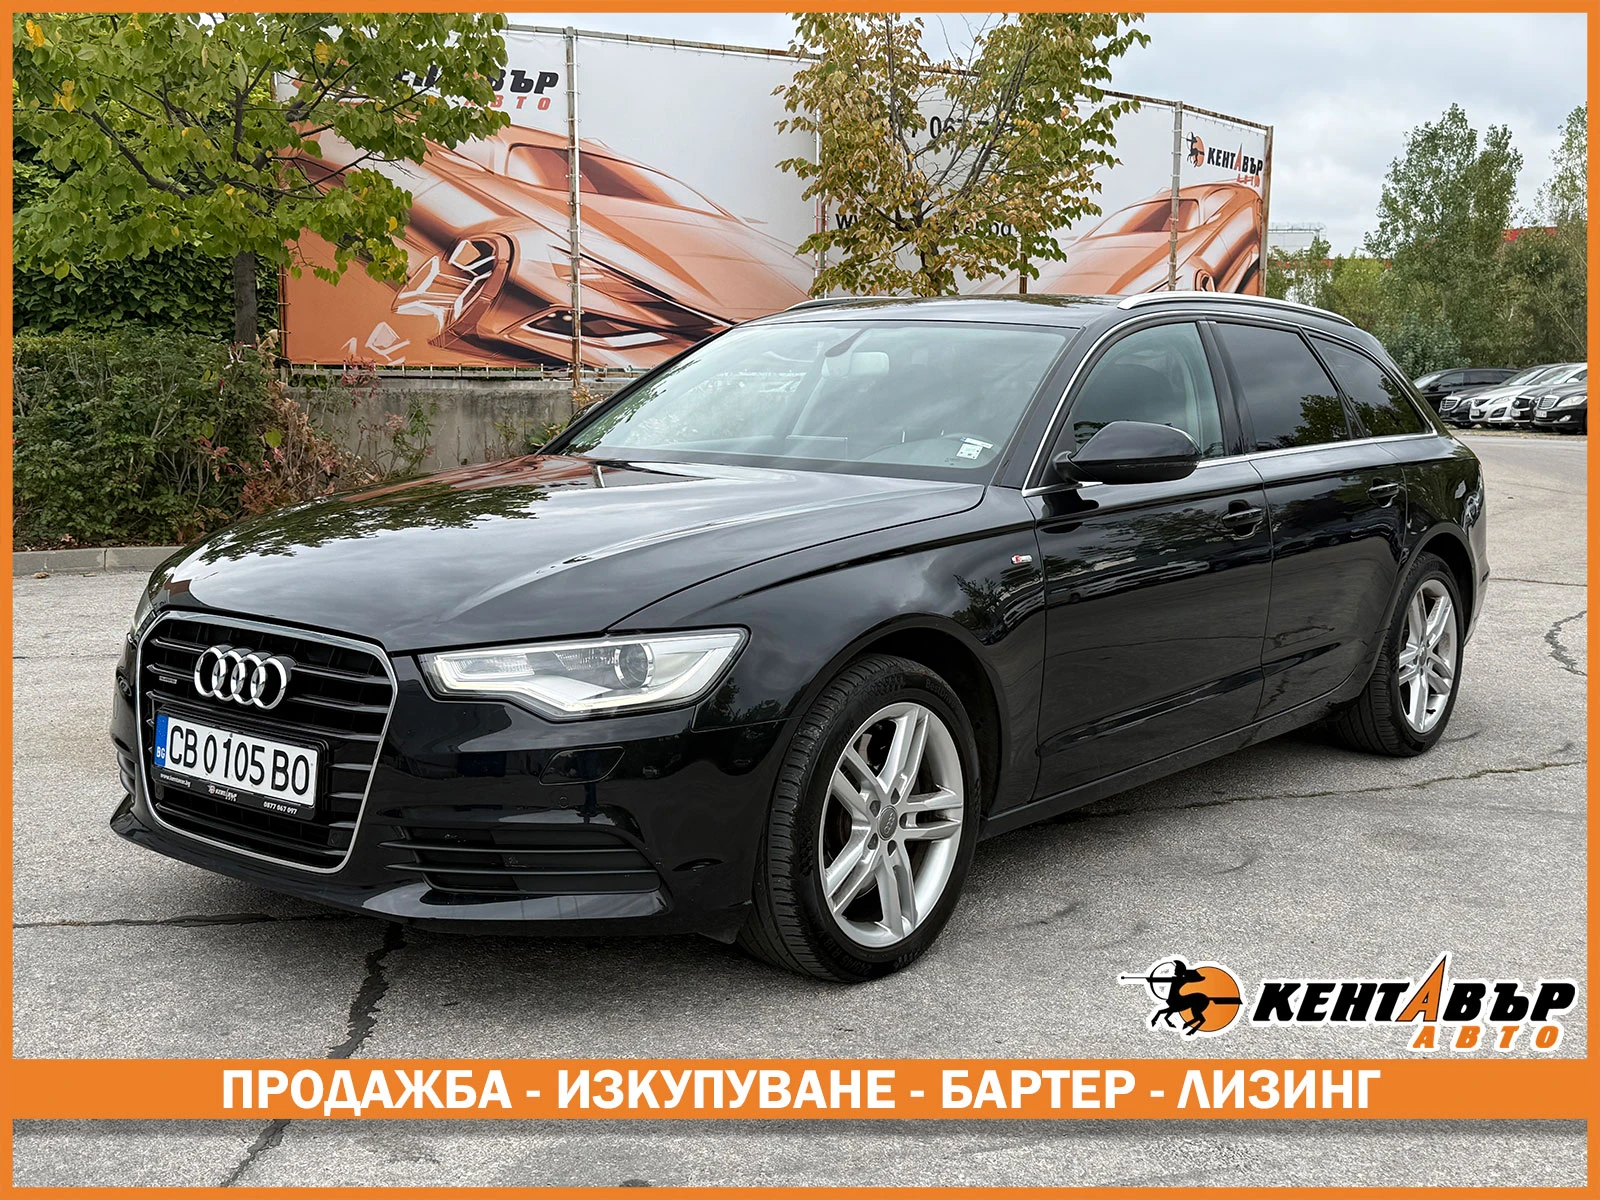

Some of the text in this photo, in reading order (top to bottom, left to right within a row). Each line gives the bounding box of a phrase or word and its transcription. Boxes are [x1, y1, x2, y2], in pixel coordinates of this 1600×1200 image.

[1207, 143, 1263, 175] КЕНТАВЪР
[156, 746, 166, 759] BG
[169, 725, 198, 769] CB
[203, 734, 265, 785] 0105
